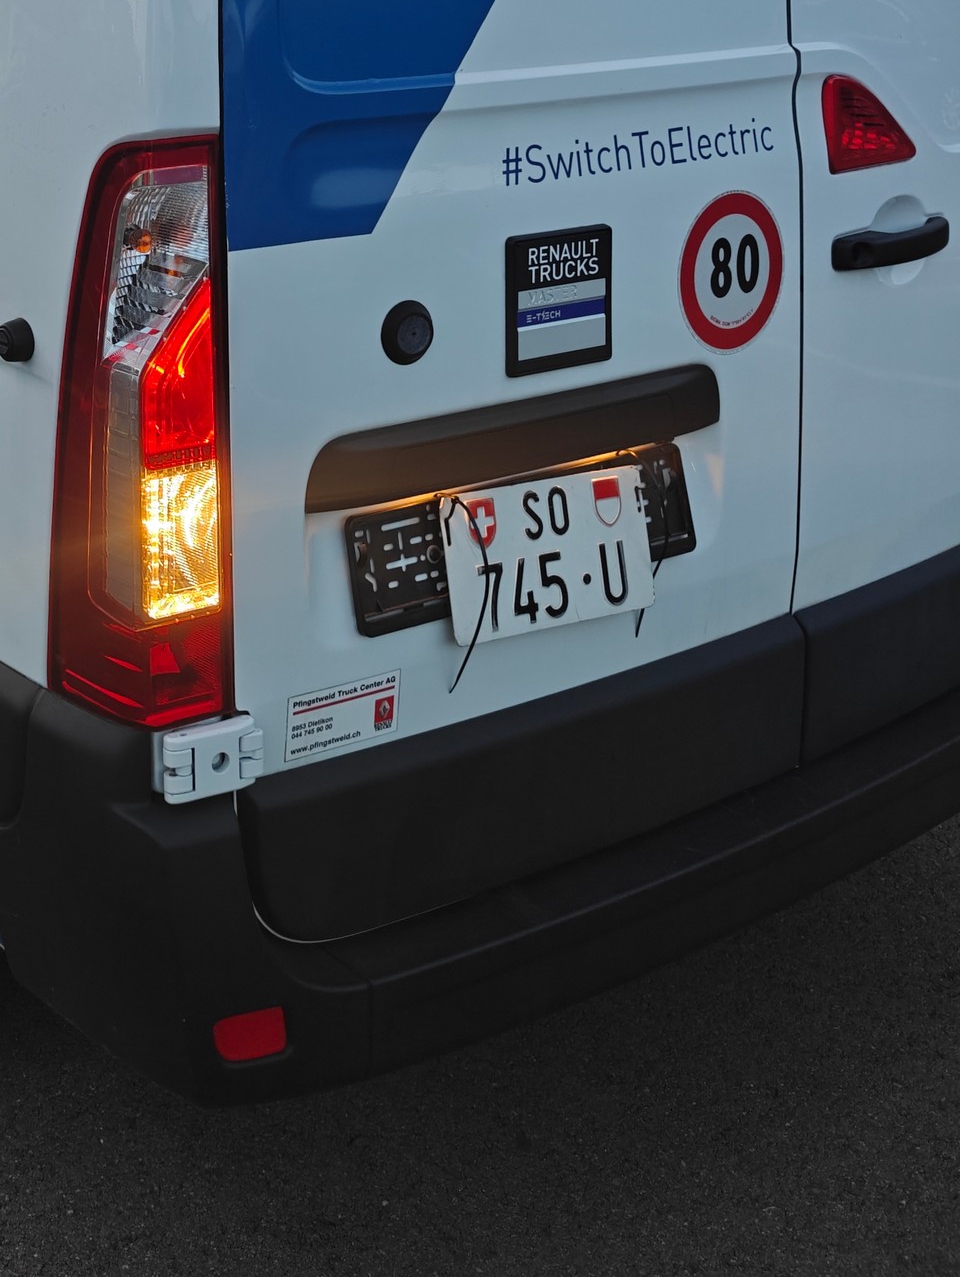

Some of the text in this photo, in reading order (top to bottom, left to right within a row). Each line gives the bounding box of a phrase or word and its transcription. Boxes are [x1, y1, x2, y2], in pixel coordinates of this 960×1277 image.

[502, 117, 774, 187] #SwitchToElectric
[528, 239, 599, 266] RENAULT
[710, 233, 760, 299] 80
[528, 257, 599, 284] TRUCKS
[527, 284, 578, 307] MASTER
[522, 485, 570, 540] SO
[292, 675, 396, 709] Pfingstweid Truck Center AG
[290, 730, 361, 756] www.pfingstweid.ch
